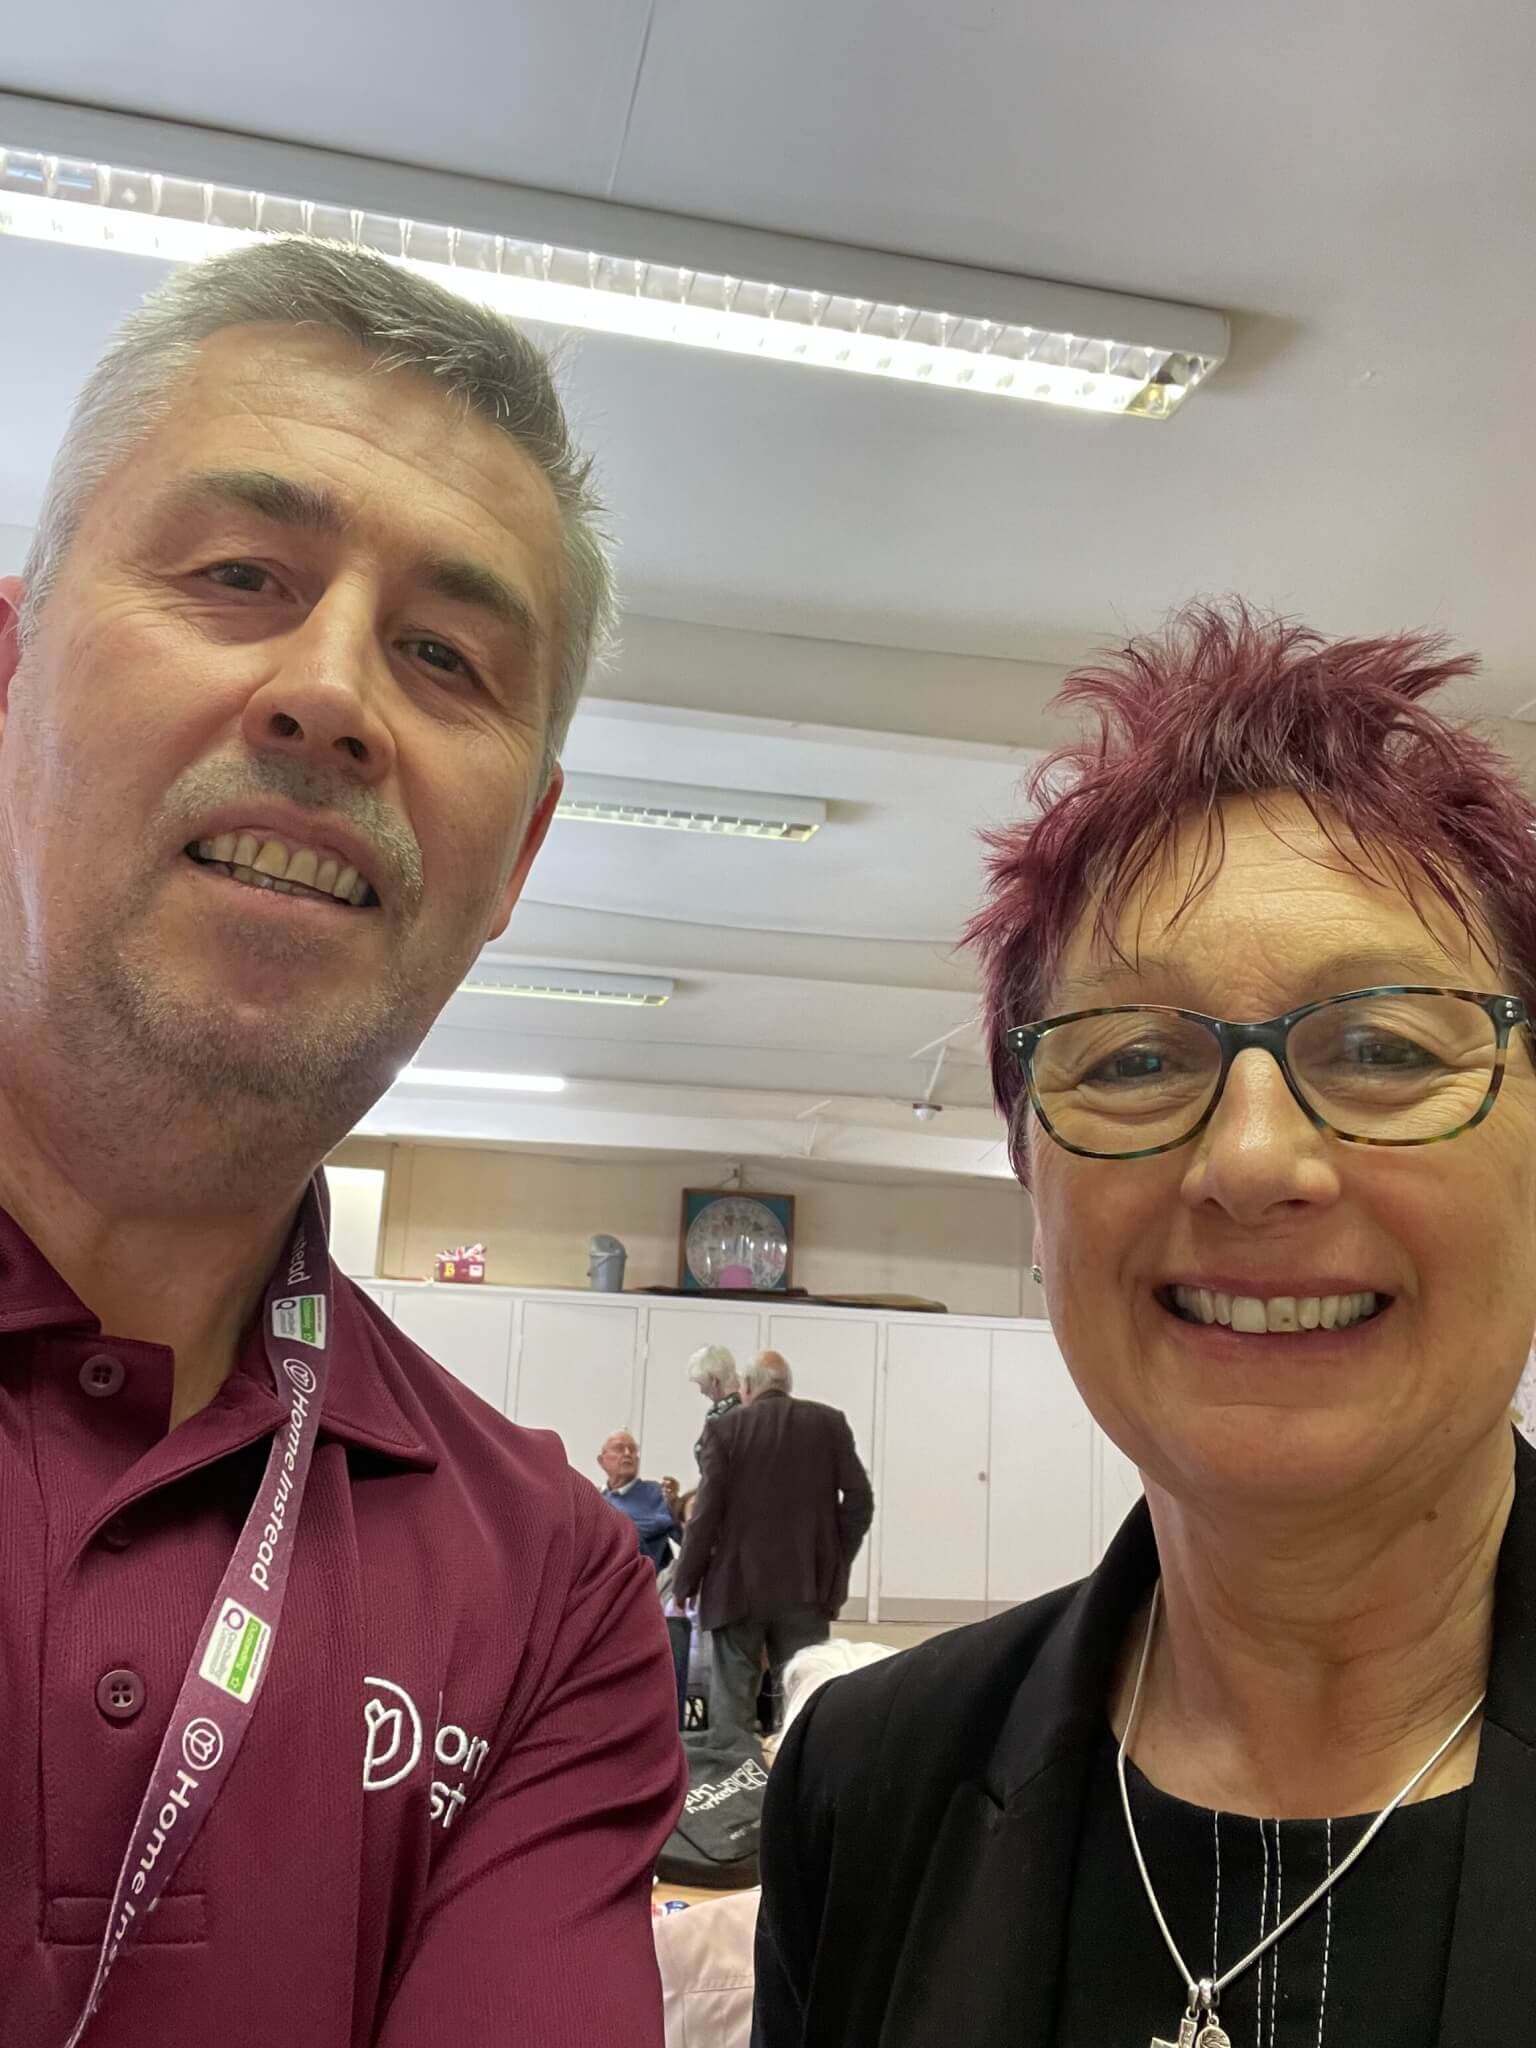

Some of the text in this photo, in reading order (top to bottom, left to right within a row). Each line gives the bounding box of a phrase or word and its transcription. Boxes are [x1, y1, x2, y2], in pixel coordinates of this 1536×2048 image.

[284, 1388, 310, 1471] Home
[250, 1470, 294, 1591] Instead
[131, 1769, 199, 1894] Home
